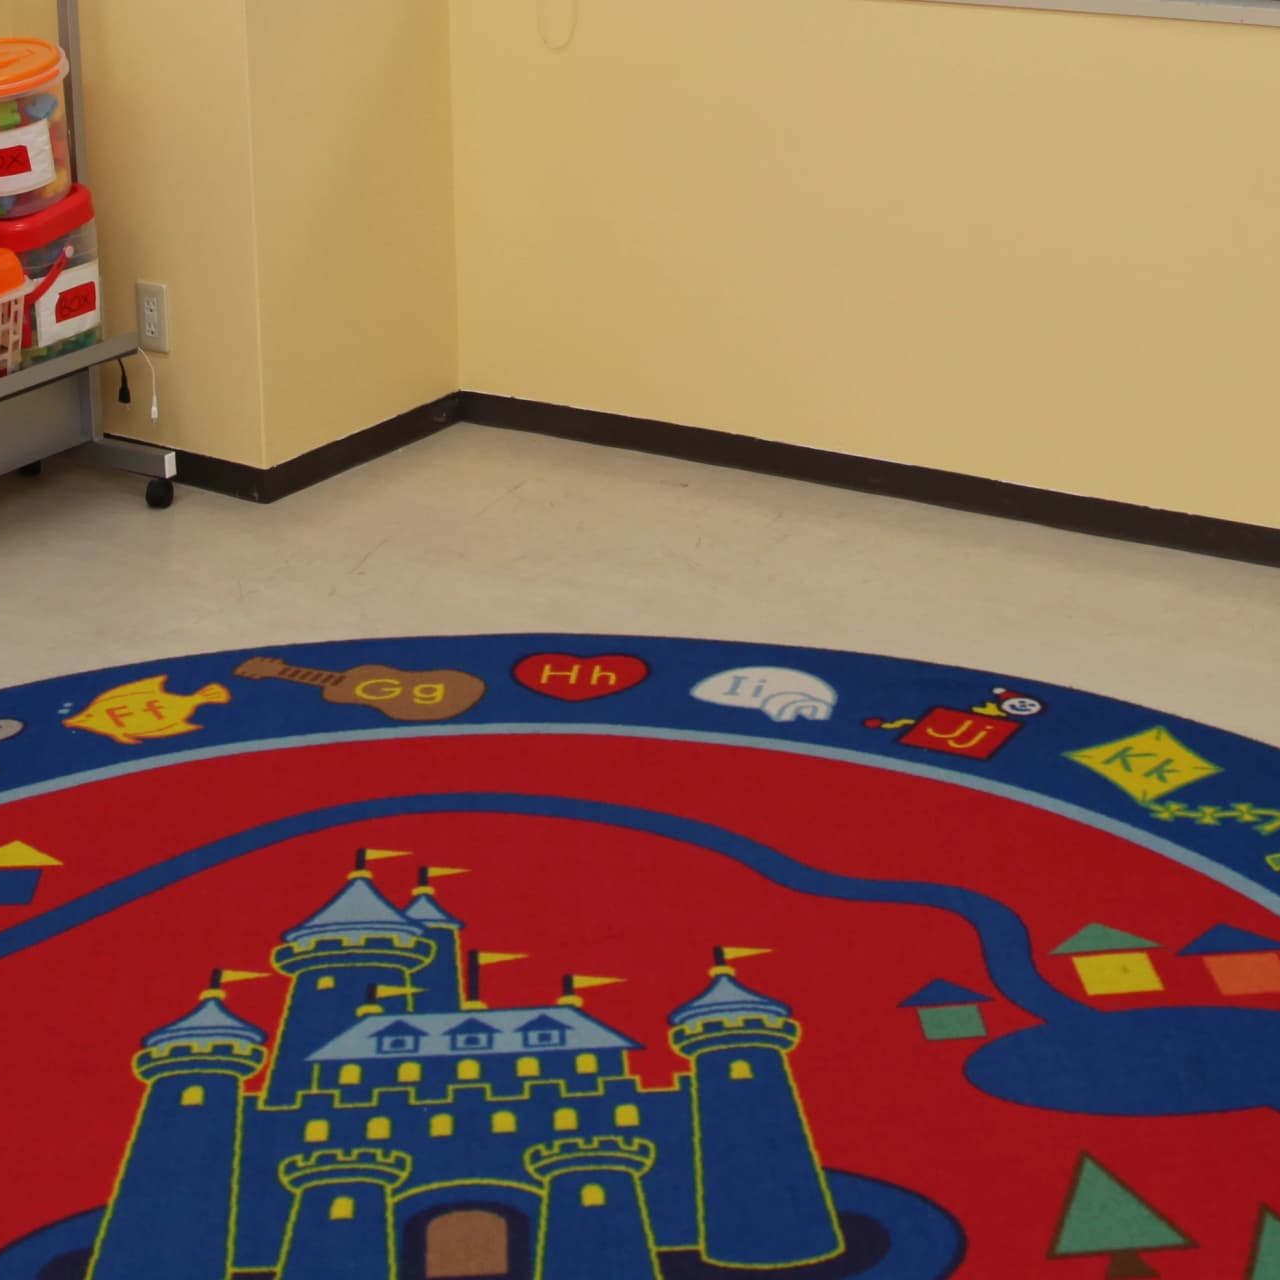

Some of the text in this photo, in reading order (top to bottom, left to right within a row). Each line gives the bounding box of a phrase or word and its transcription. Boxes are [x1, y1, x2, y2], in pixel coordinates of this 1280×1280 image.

[539, 662, 618, 686] Hh
[354, 677, 446, 704] Gg
[105, 699, 164, 728] Ff
[924, 717, 989, 749] Jj
[1102, 746, 1180, 783] Kk
